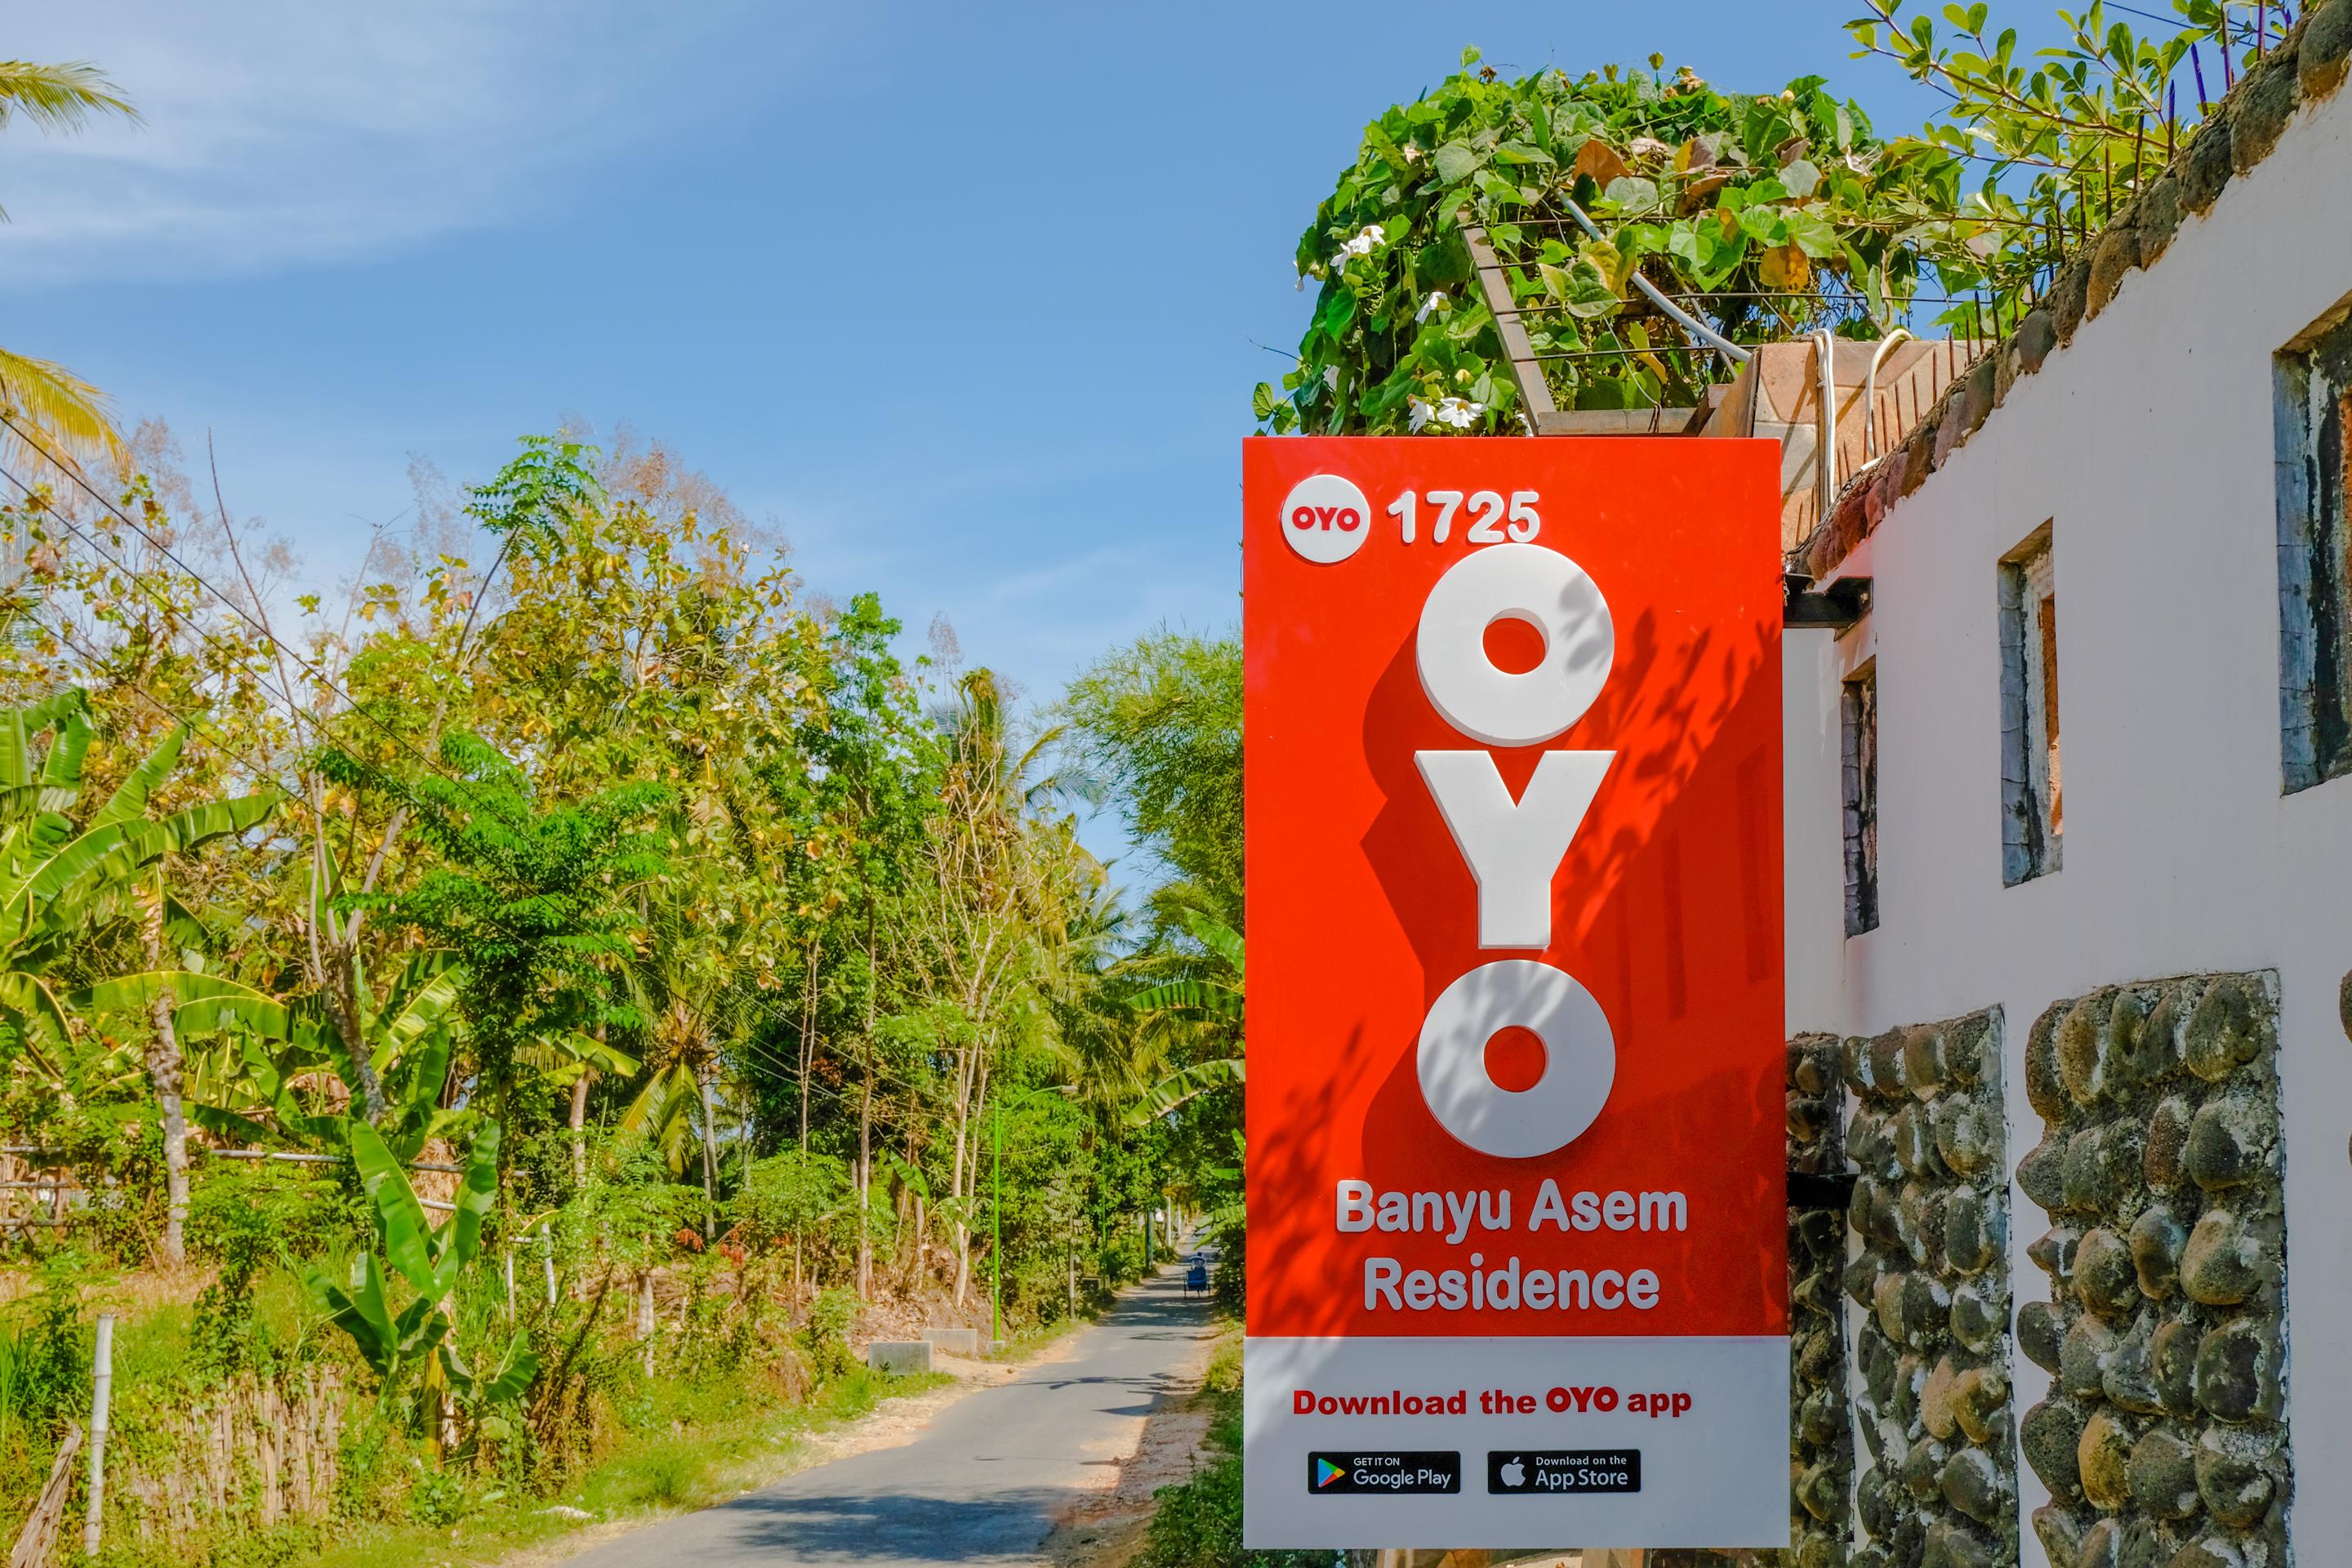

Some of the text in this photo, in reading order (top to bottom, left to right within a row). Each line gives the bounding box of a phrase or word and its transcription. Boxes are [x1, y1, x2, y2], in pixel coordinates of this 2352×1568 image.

[1292, 506, 1361, 532] OYO
[1388, 490, 1540, 544] 1725
[1414, 543, 1617, 1159] OYO
[1335, 1178, 1688, 1245] Banyu Asem
[1364, 1253, 1660, 1311] Residence
[1293, 1387, 1692, 1418] Download the OYO app
[1353, 1457, 1400, 1466] GET IT ON
[1535, 1455, 1627, 1466] Download on the
[1353, 1469, 1451, 1490] Google Play
[1535, 1468, 1628, 1490] App Store
